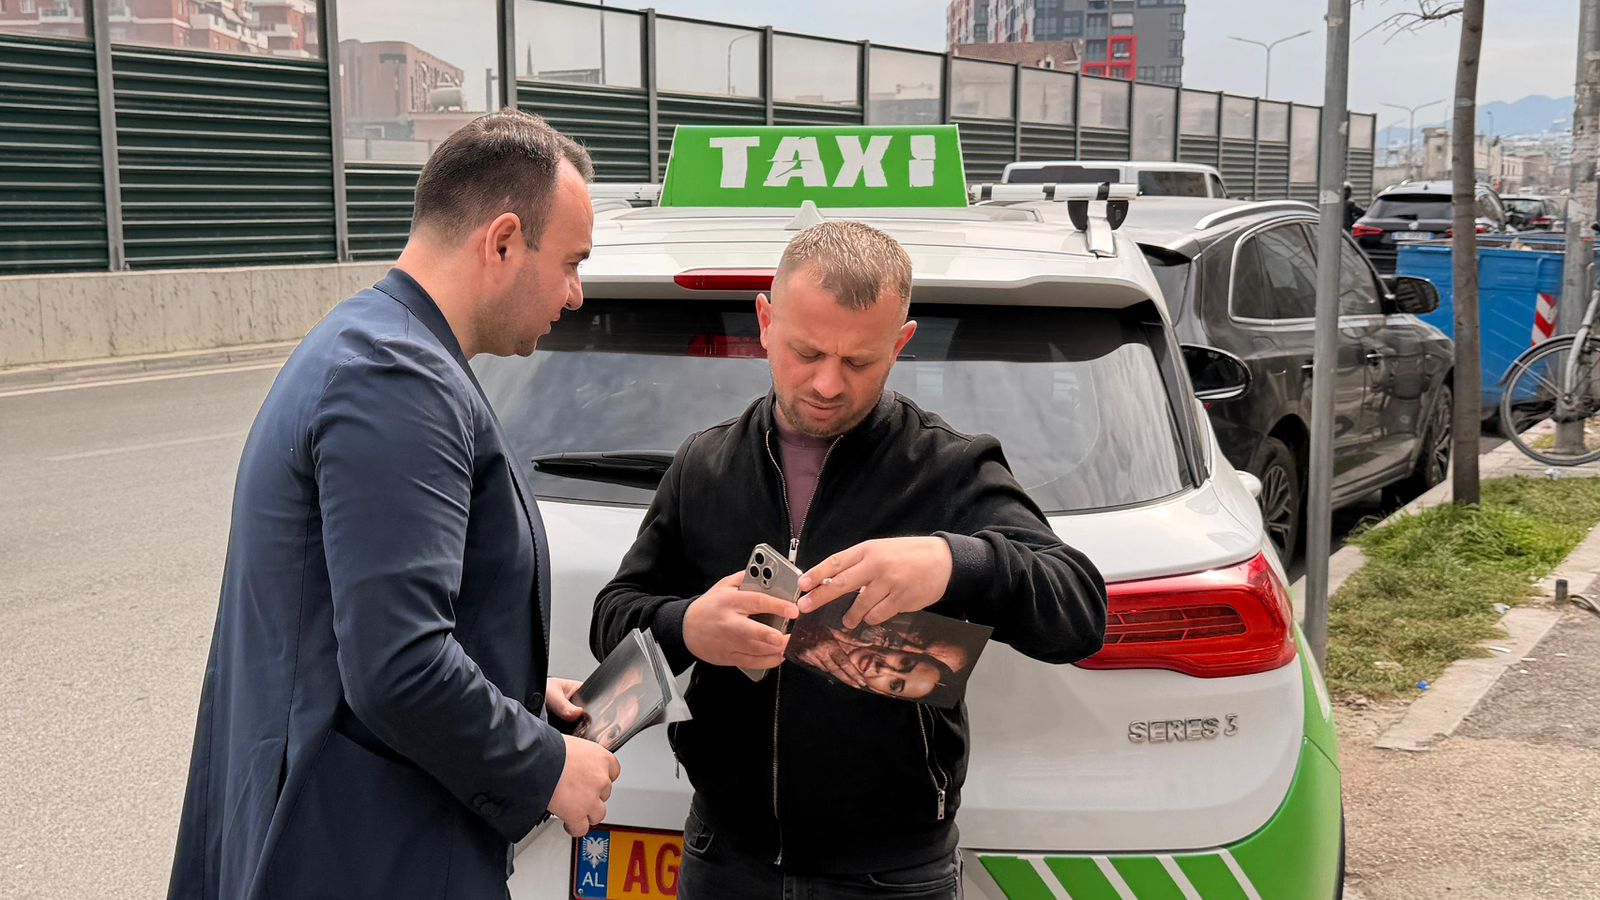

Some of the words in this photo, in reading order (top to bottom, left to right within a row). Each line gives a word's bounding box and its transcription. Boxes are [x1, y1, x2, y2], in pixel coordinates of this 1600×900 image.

[708, 135, 937, 189] TAXI
[1128, 717, 1219, 743] SERES
[1223, 712, 1239, 736] 3
[581, 870, 605, 888] AL
[622, 839, 682, 897] AG
